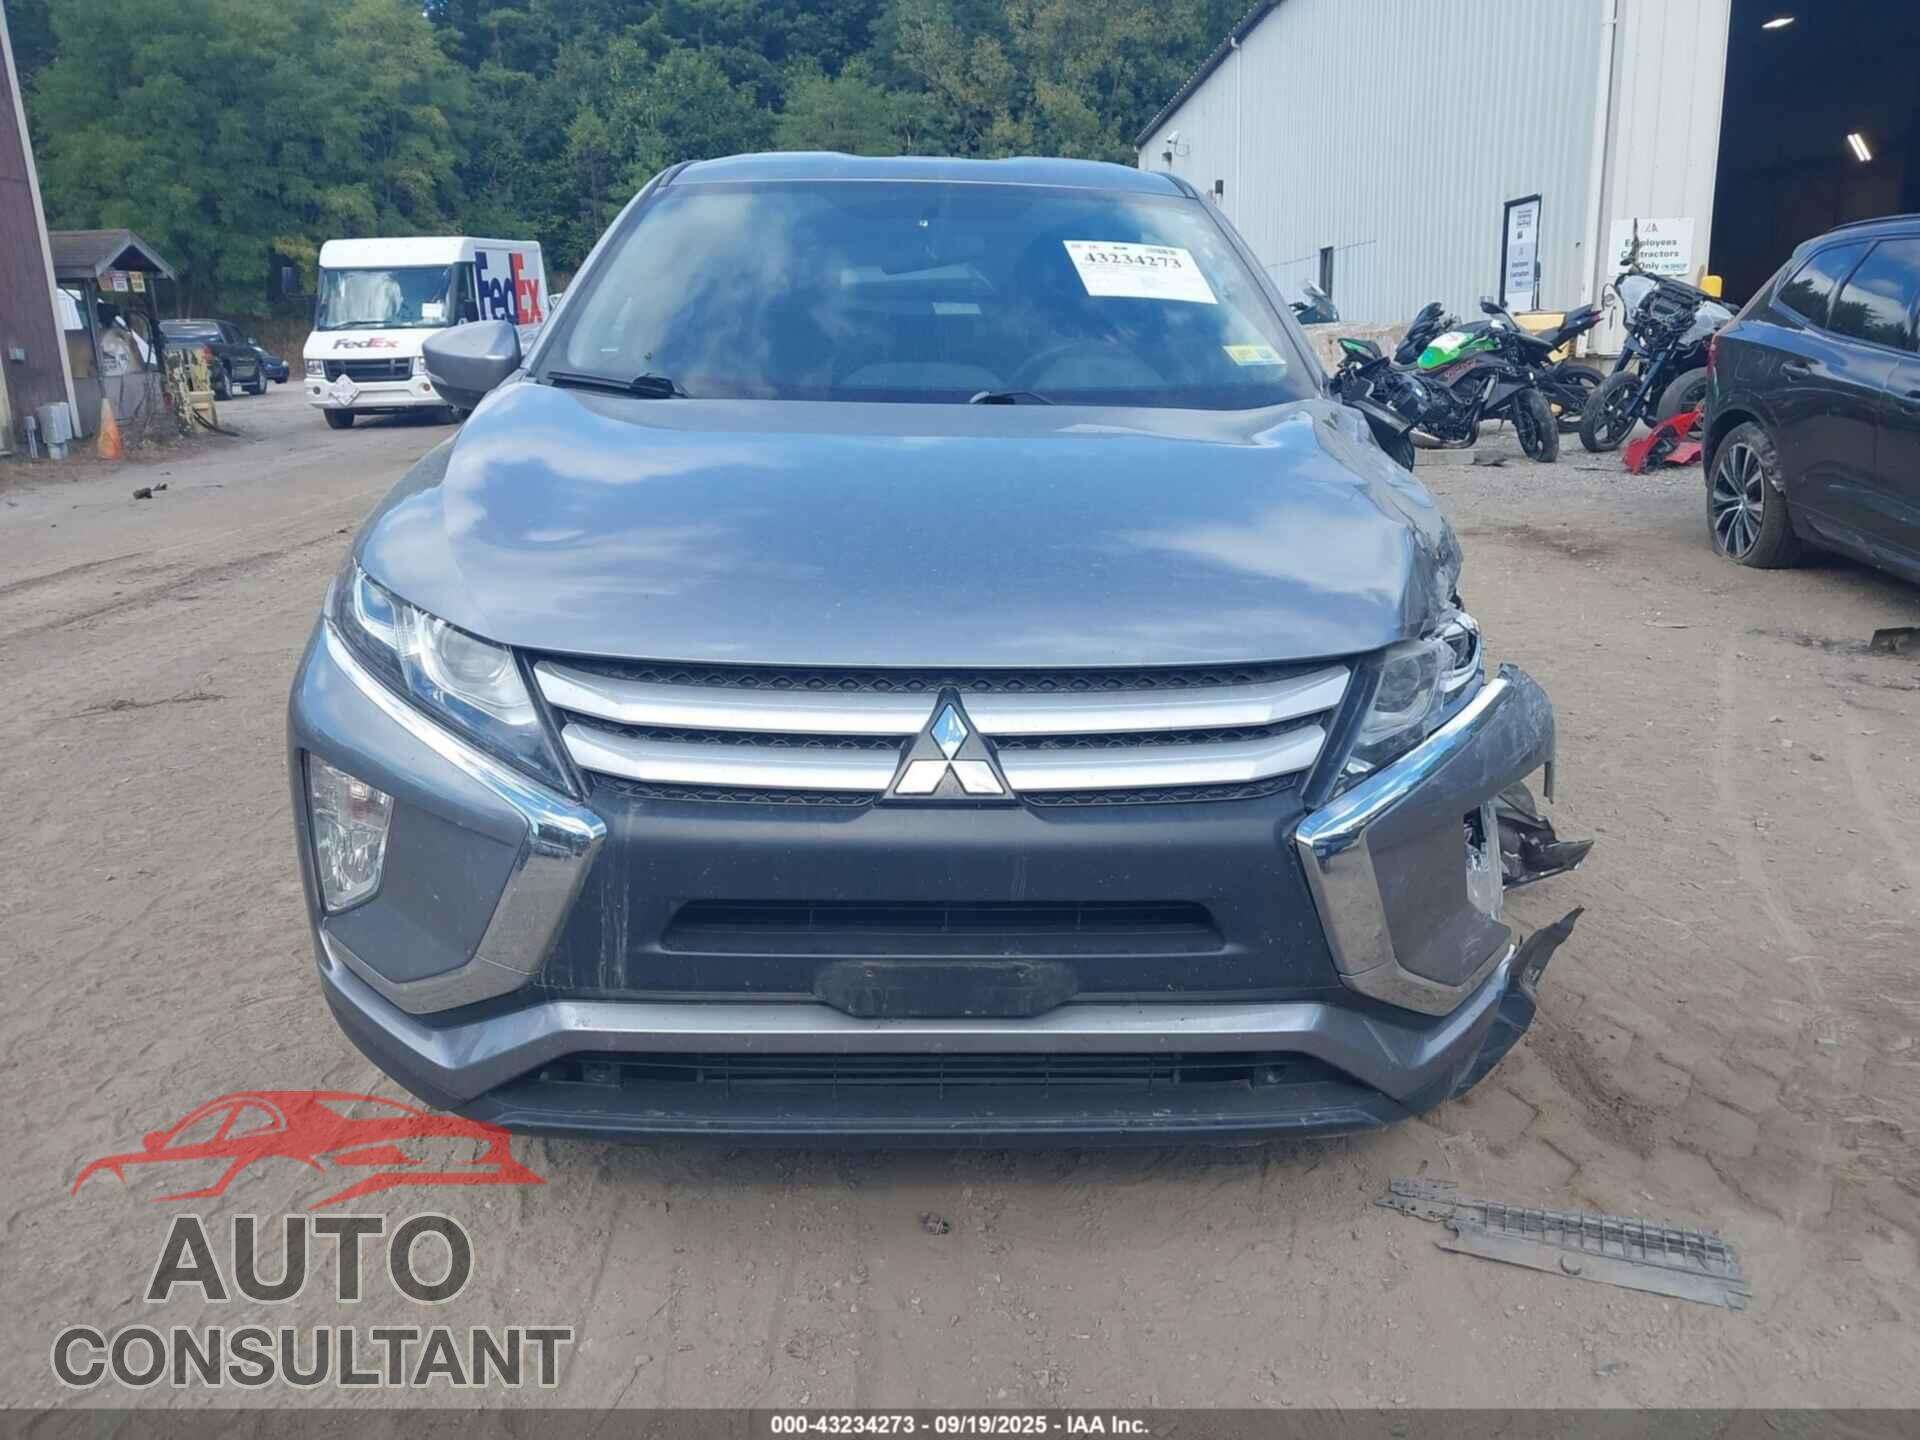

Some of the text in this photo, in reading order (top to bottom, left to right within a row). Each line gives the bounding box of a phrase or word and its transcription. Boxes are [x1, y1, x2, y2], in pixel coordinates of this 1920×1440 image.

[1625, 239, 1677, 248] Eployees
[1086, 253, 1182, 268] 43234273
[1621, 250, 1679, 258] Ctractors
[475, 252, 542, 325] FedEx
[333, 337, 399, 350] FedEx
